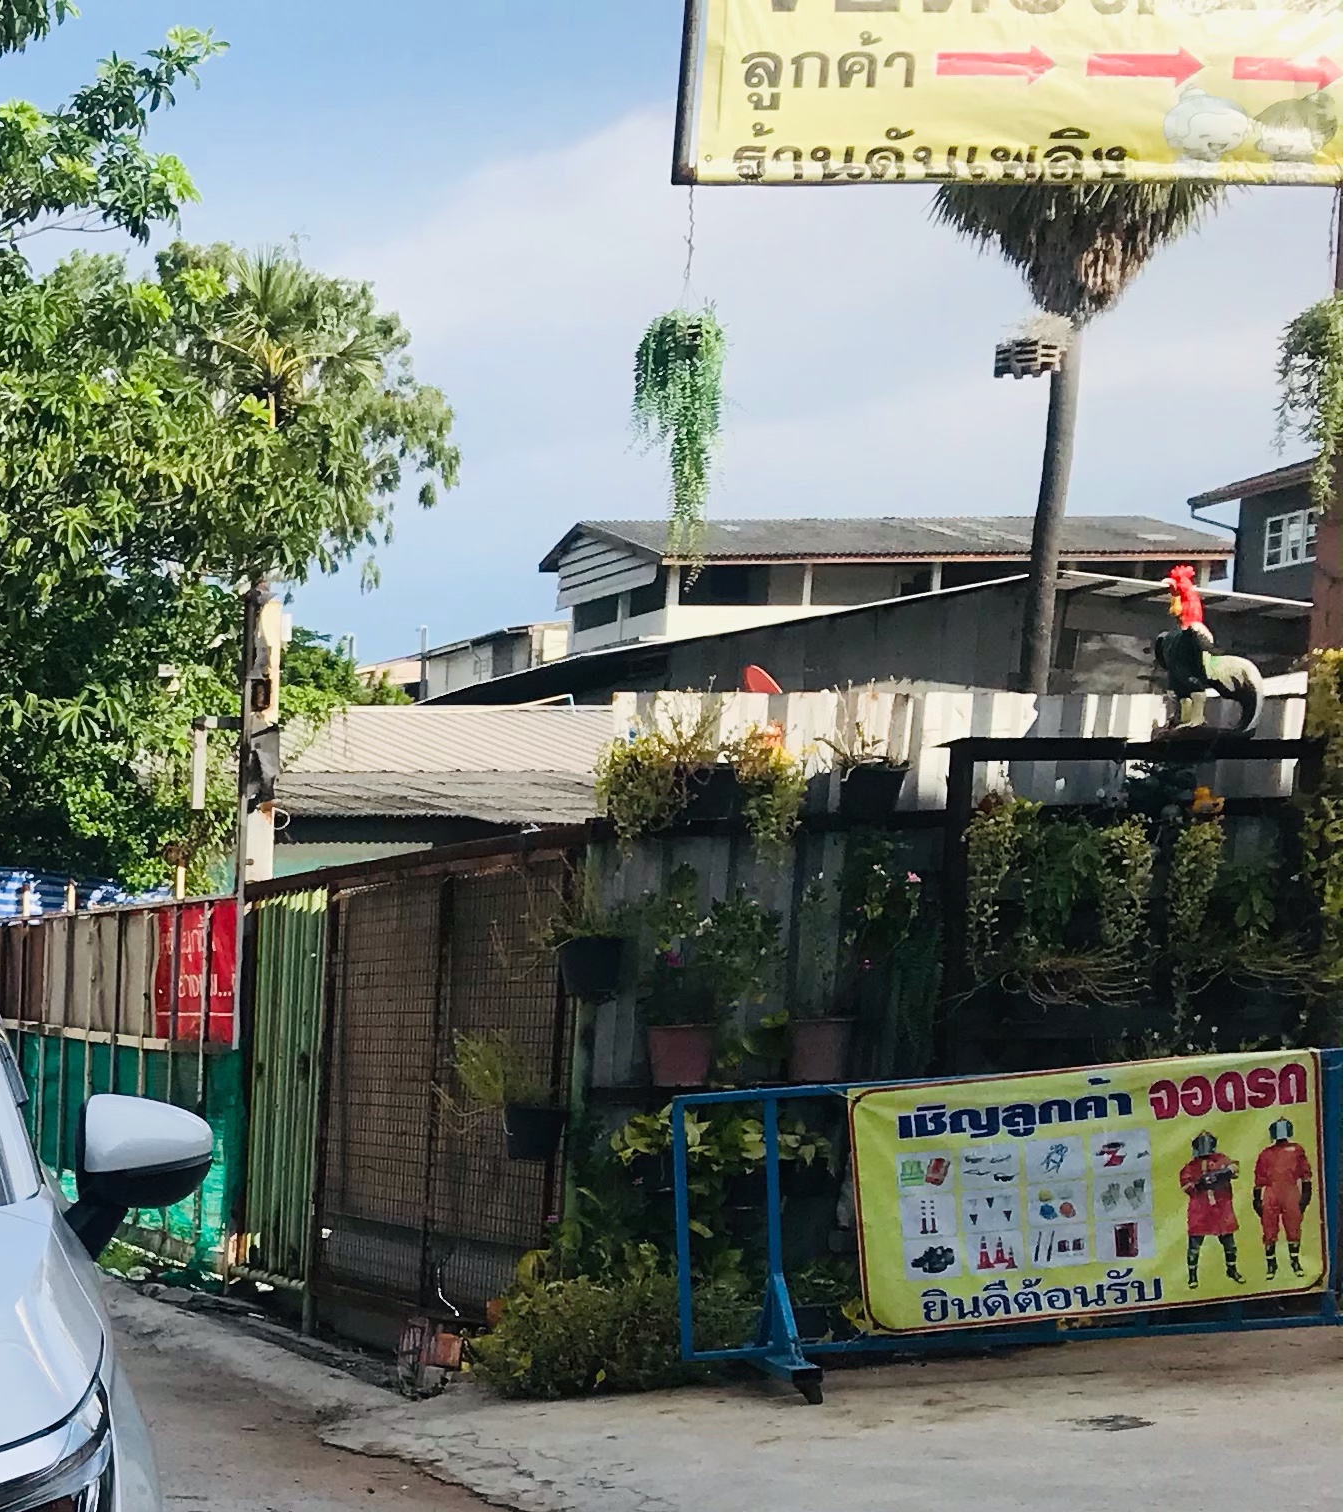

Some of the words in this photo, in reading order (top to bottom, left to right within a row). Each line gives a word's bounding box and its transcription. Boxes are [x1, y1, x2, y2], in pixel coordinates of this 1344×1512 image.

[741, 31, 916, 111] ลูกค้า
[898, 1076, 1133, 1139] เชิญลูกค้า
[1148, 1063, 1309, 1120] จอดรถ
[922, 1267, 1164, 1323] ยินดีต้อนรับ
